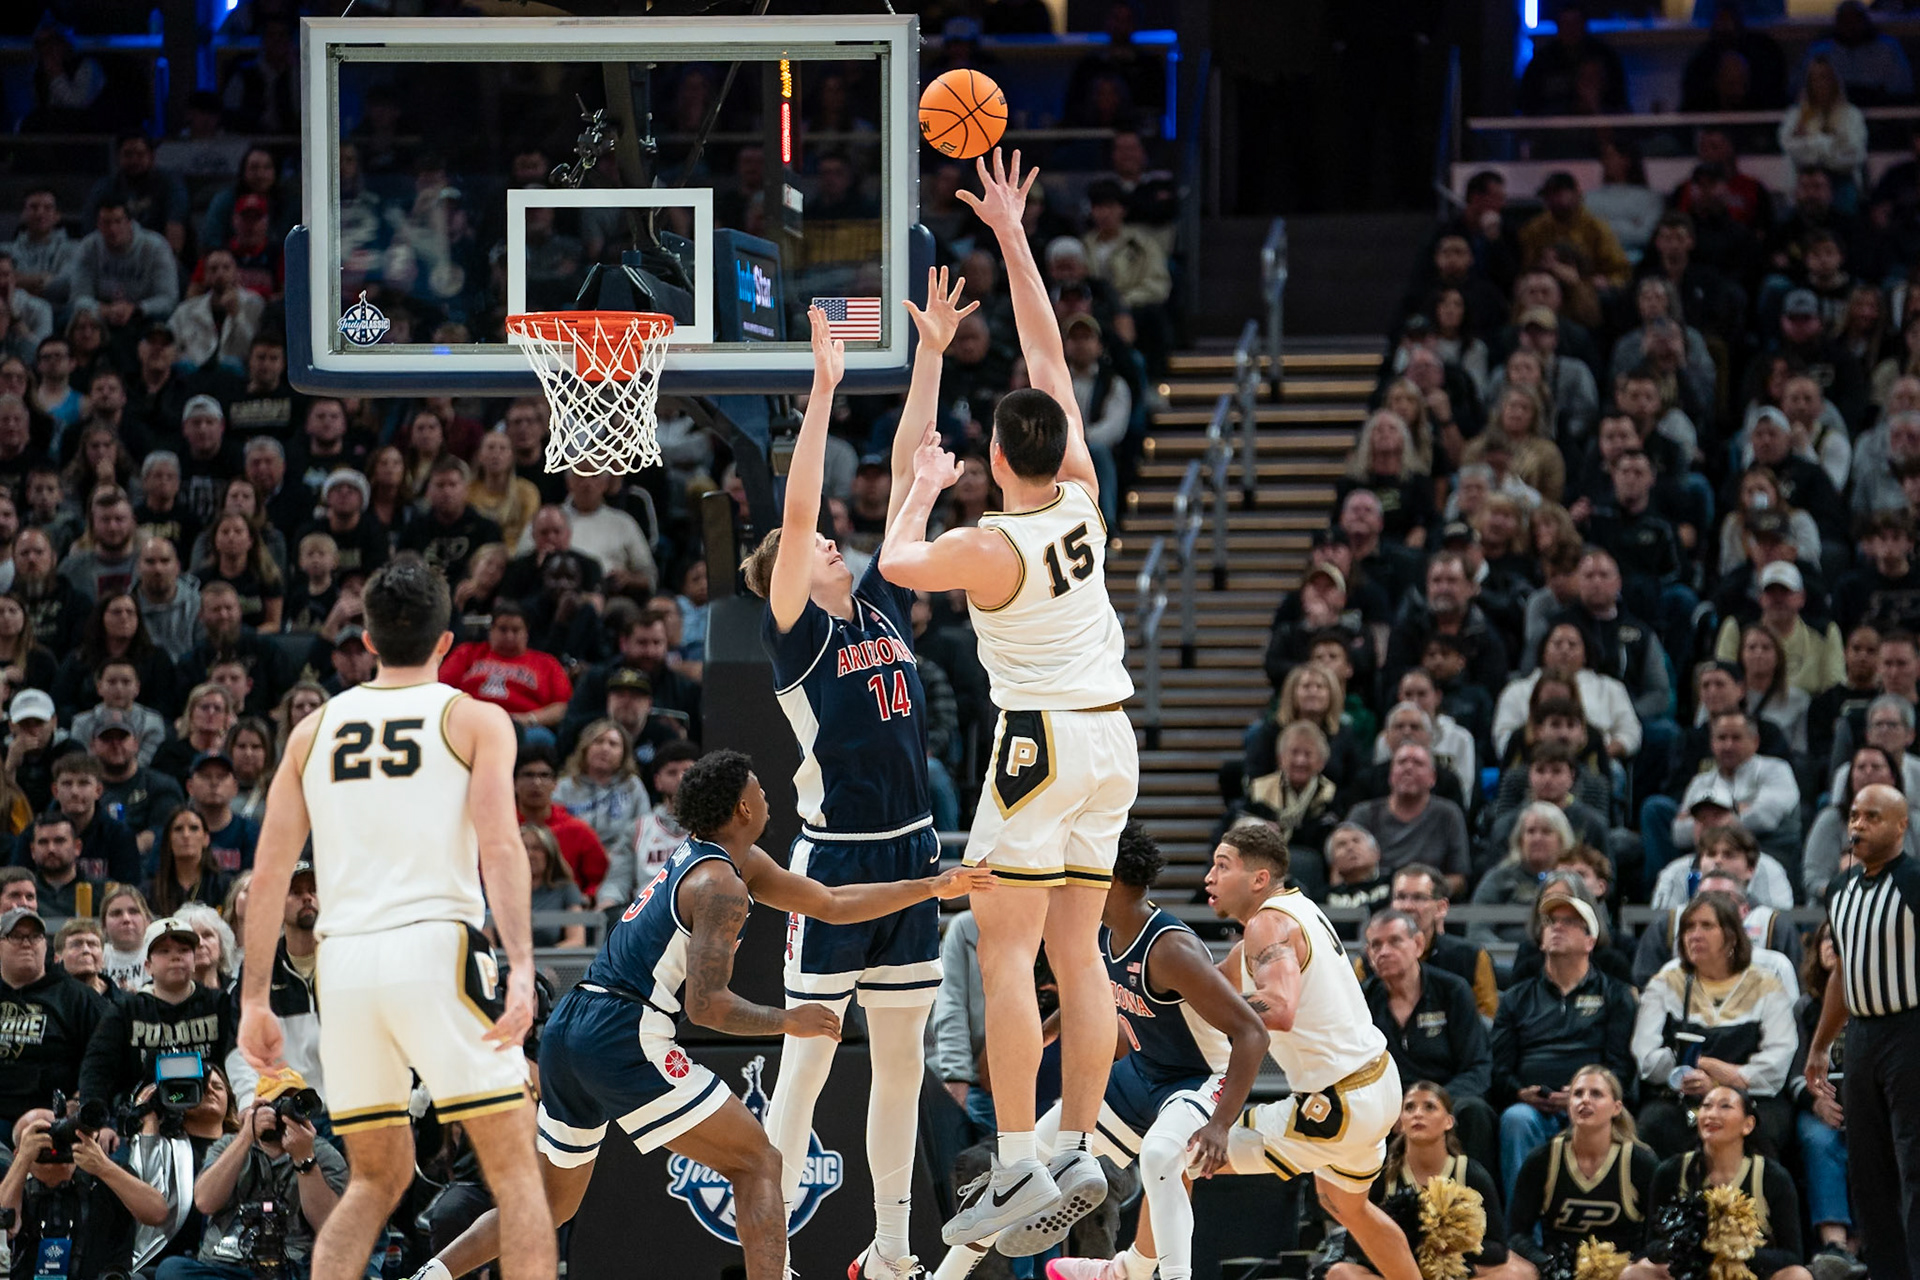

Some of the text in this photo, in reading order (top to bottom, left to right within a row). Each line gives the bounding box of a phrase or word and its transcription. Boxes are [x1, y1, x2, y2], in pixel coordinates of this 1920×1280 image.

[1043, 521, 1095, 599] 15
[867, 670, 912, 722] 14
[331, 717, 424, 783] 25
[1005, 736, 1038, 776] P
[621, 868, 668, 922] 5
[474, 950, 499, 1000] P
[1554, 1198, 1621, 1233] P
